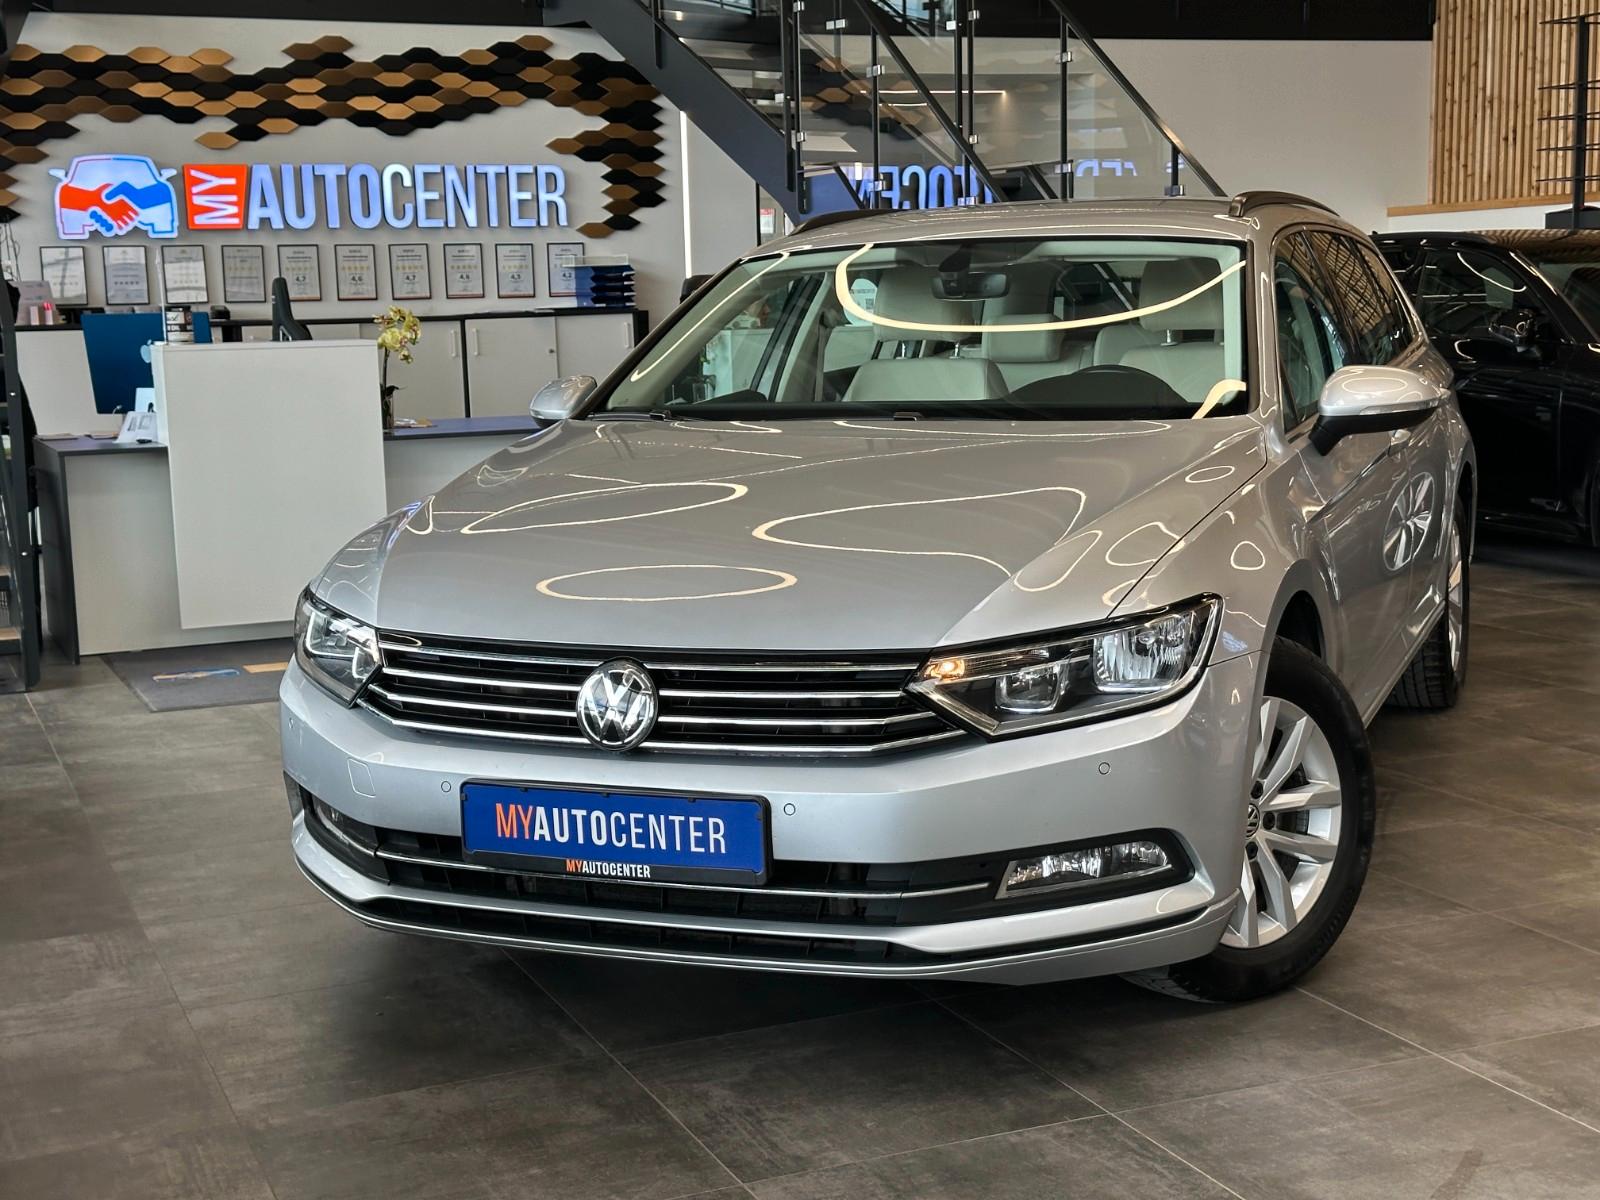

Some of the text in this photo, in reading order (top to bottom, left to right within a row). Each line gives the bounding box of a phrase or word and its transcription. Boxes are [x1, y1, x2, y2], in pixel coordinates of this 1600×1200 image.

[191, 163, 568, 229] MY AUTOCENTER
[495, 803, 726, 854] MYAUTOCENTER
[565, 858, 651, 879] MYAUTOCENTER
